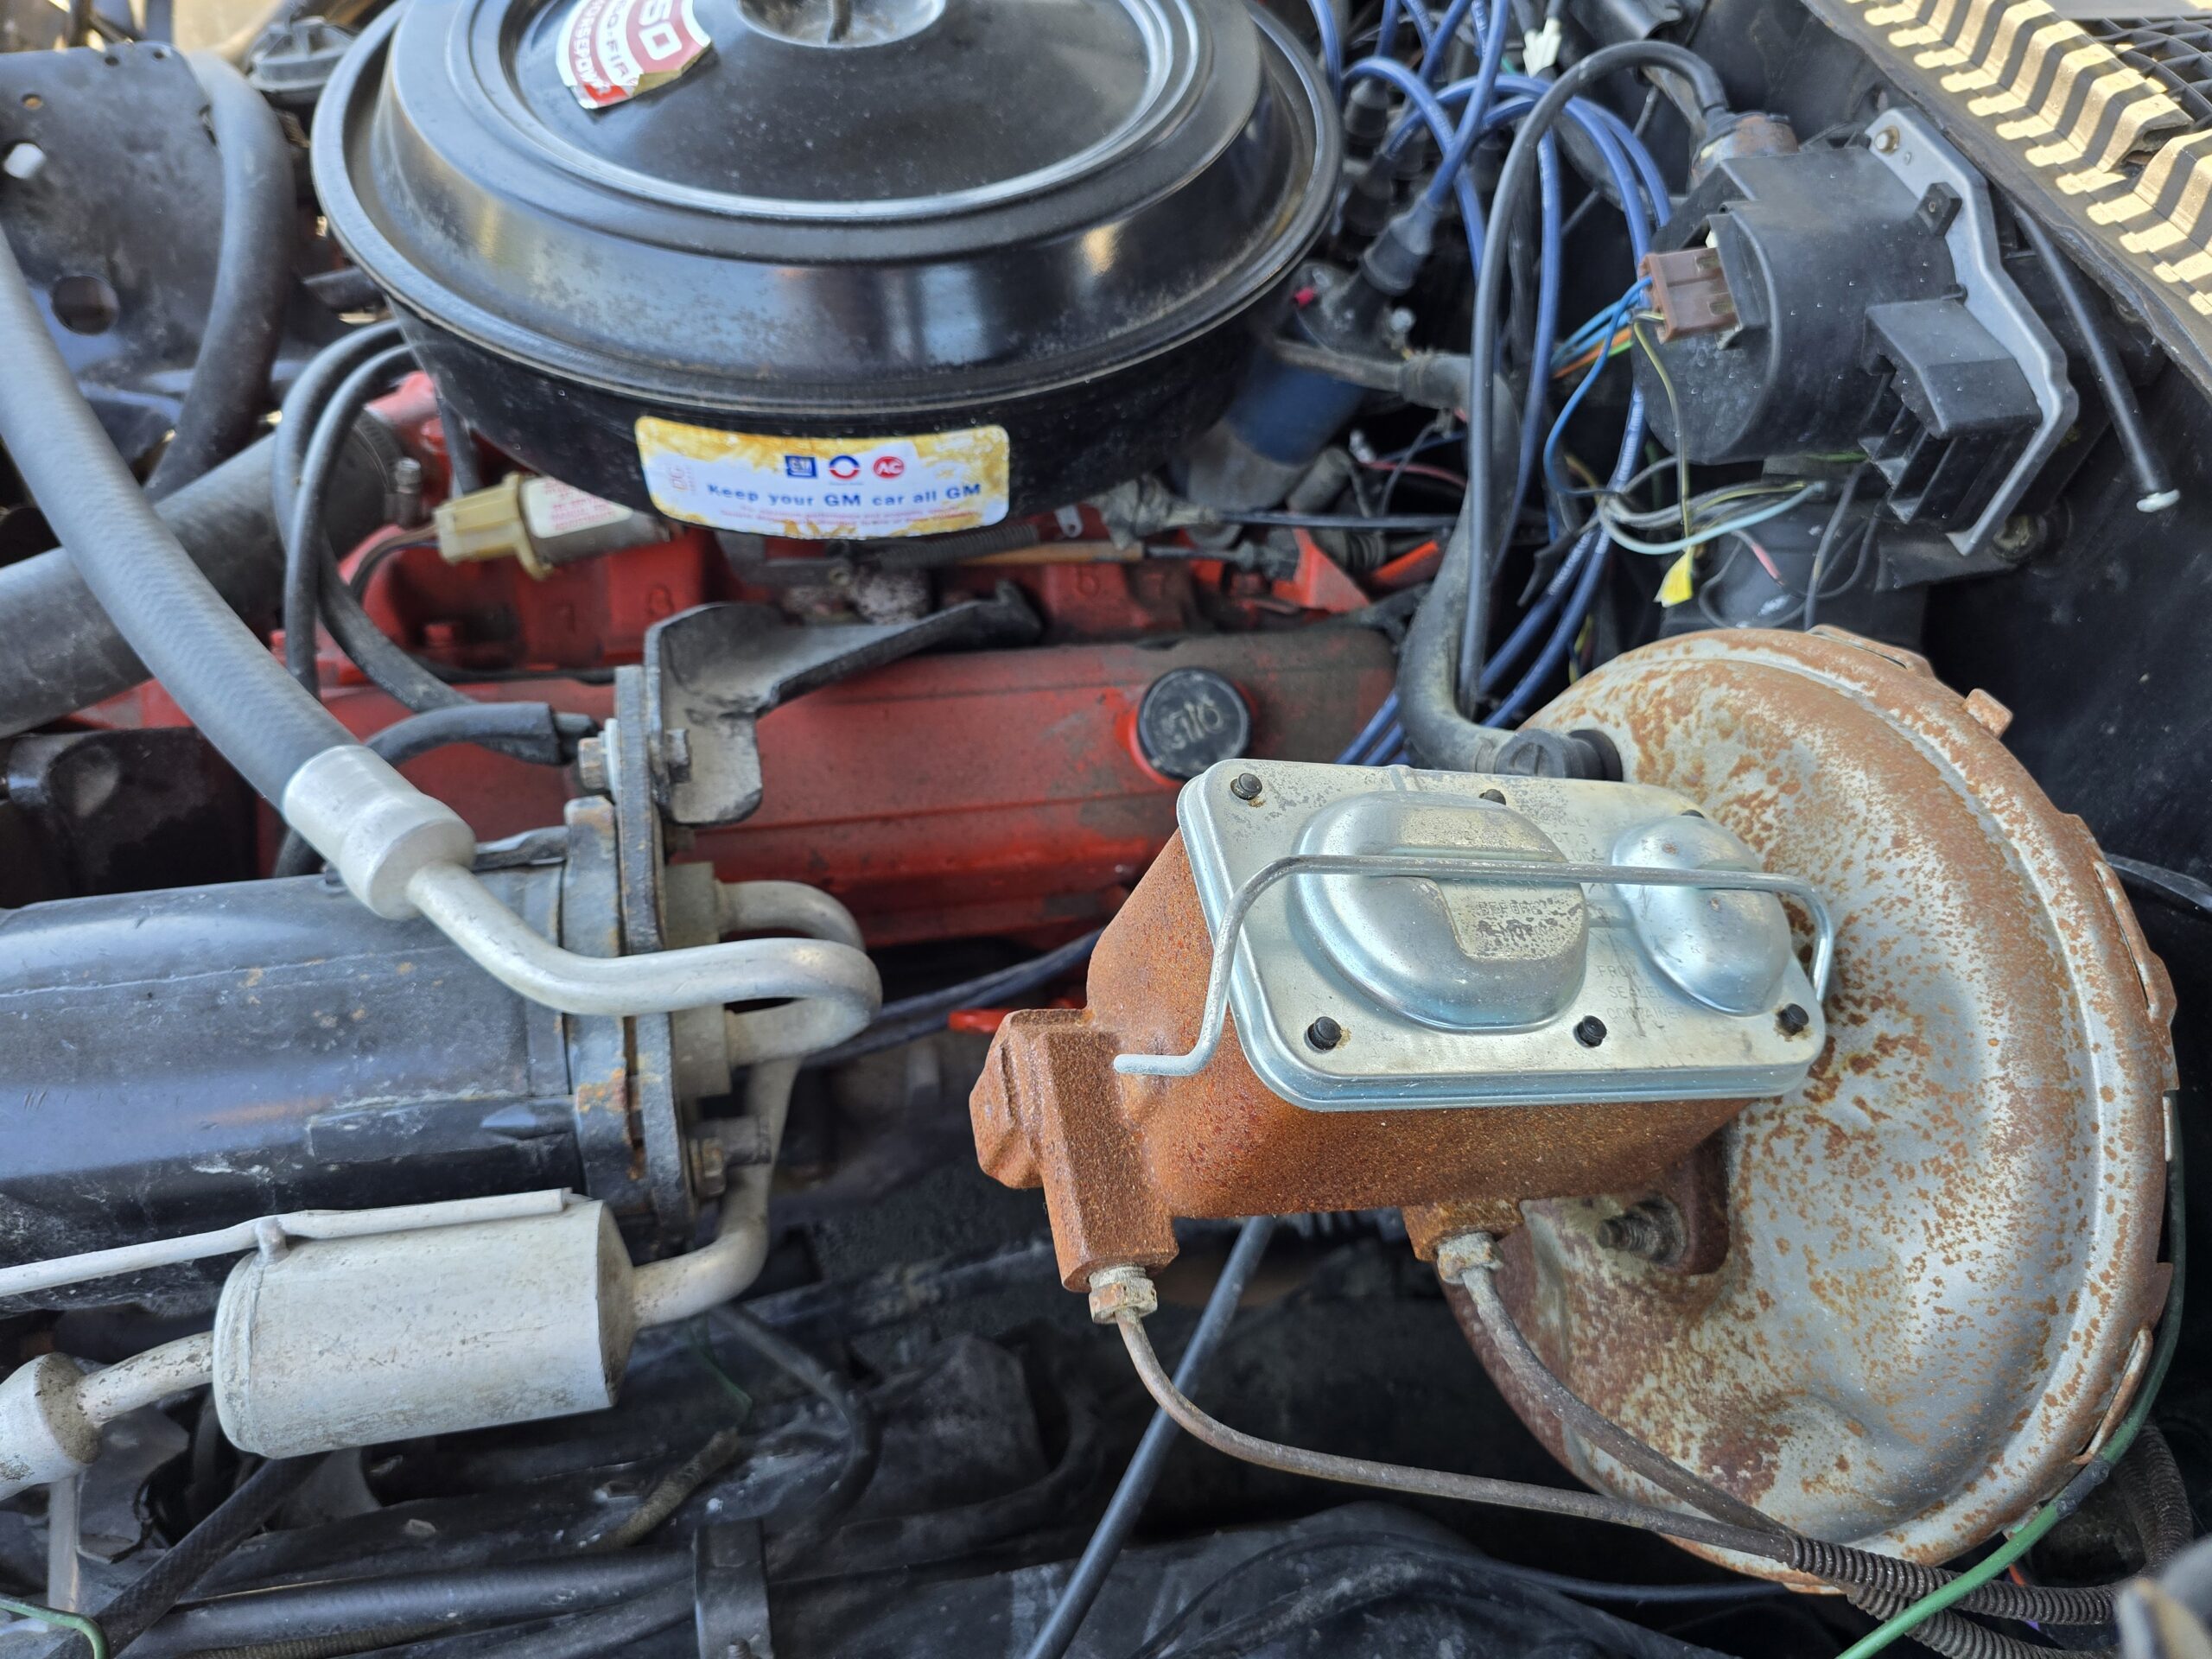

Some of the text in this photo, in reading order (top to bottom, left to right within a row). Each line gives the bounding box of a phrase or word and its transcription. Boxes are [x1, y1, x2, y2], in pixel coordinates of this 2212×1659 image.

[876, 460, 904, 476] AC
[707, 483, 981, 507] Keep your GM car all GM
[1478, 900, 1543, 916] BEFORE
[1596, 965, 1639, 978] FROM
[1607, 985, 1665, 999] SEALED
[1606, 1007, 1686, 1020] CONTAINER
